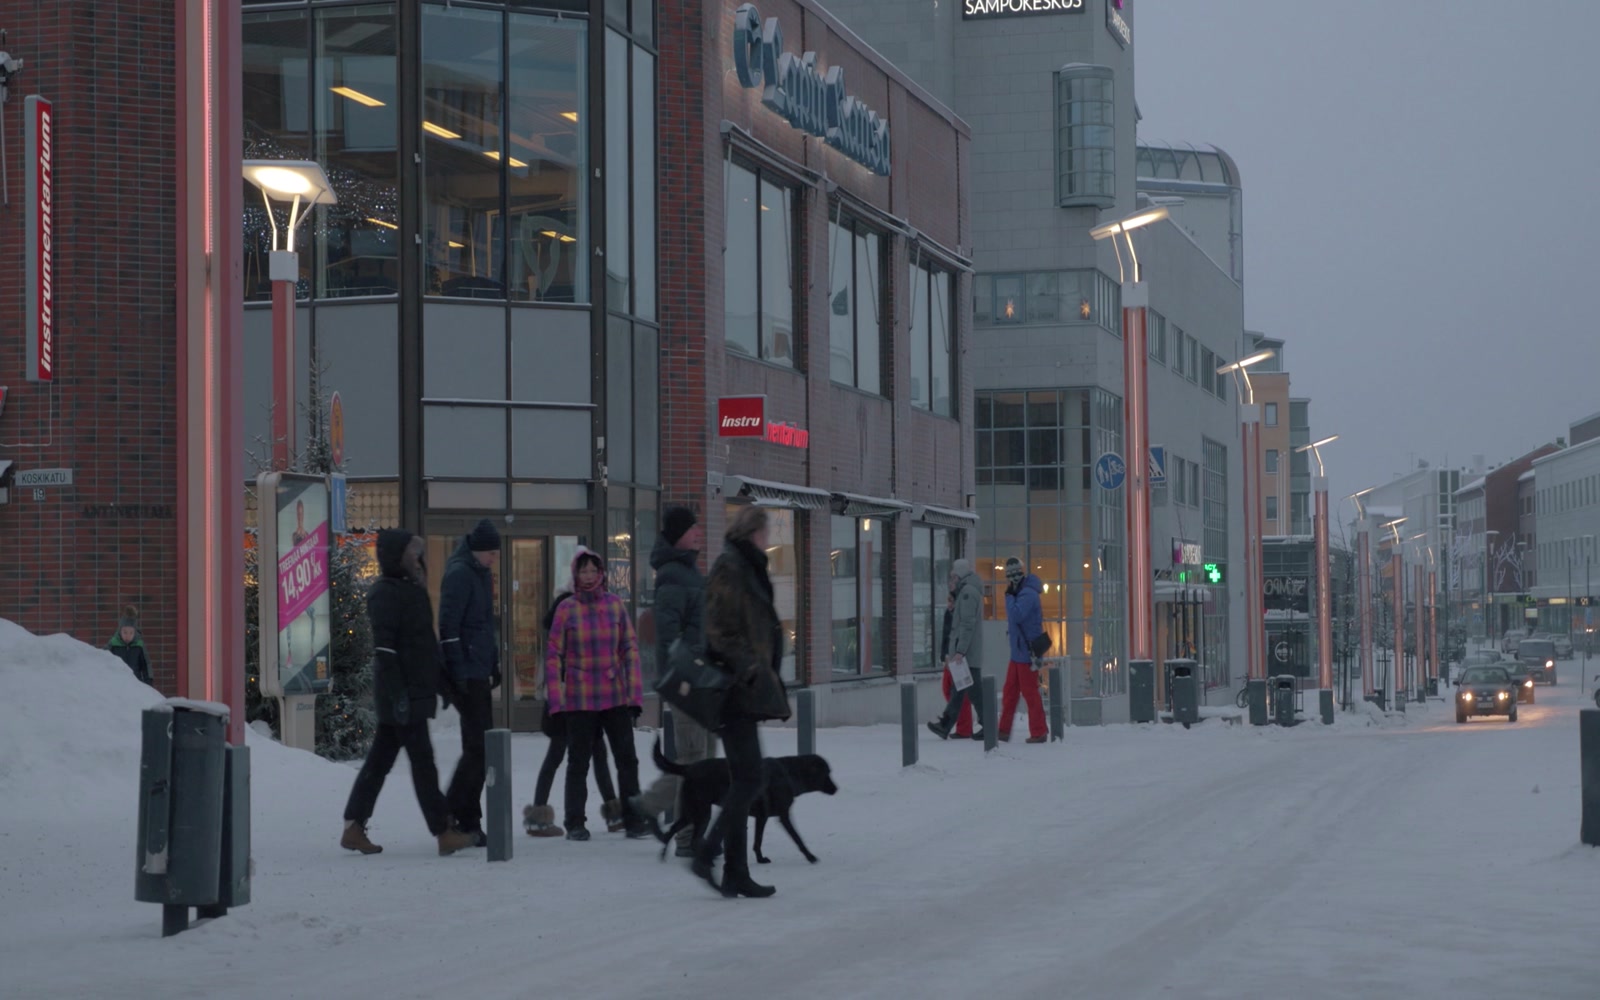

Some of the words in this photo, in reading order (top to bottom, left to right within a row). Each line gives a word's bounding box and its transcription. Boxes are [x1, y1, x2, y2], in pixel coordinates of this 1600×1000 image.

[966, 0, 1082, 15] SAMPOKESKUS
[41, 111, 51, 372] instrumentarium
[722, 415, 760, 428] instru
[22, 473, 65, 484] KOSKIKATU
[34, 489, 44, 499] 19
[282, 558, 311, 604] 14,90
